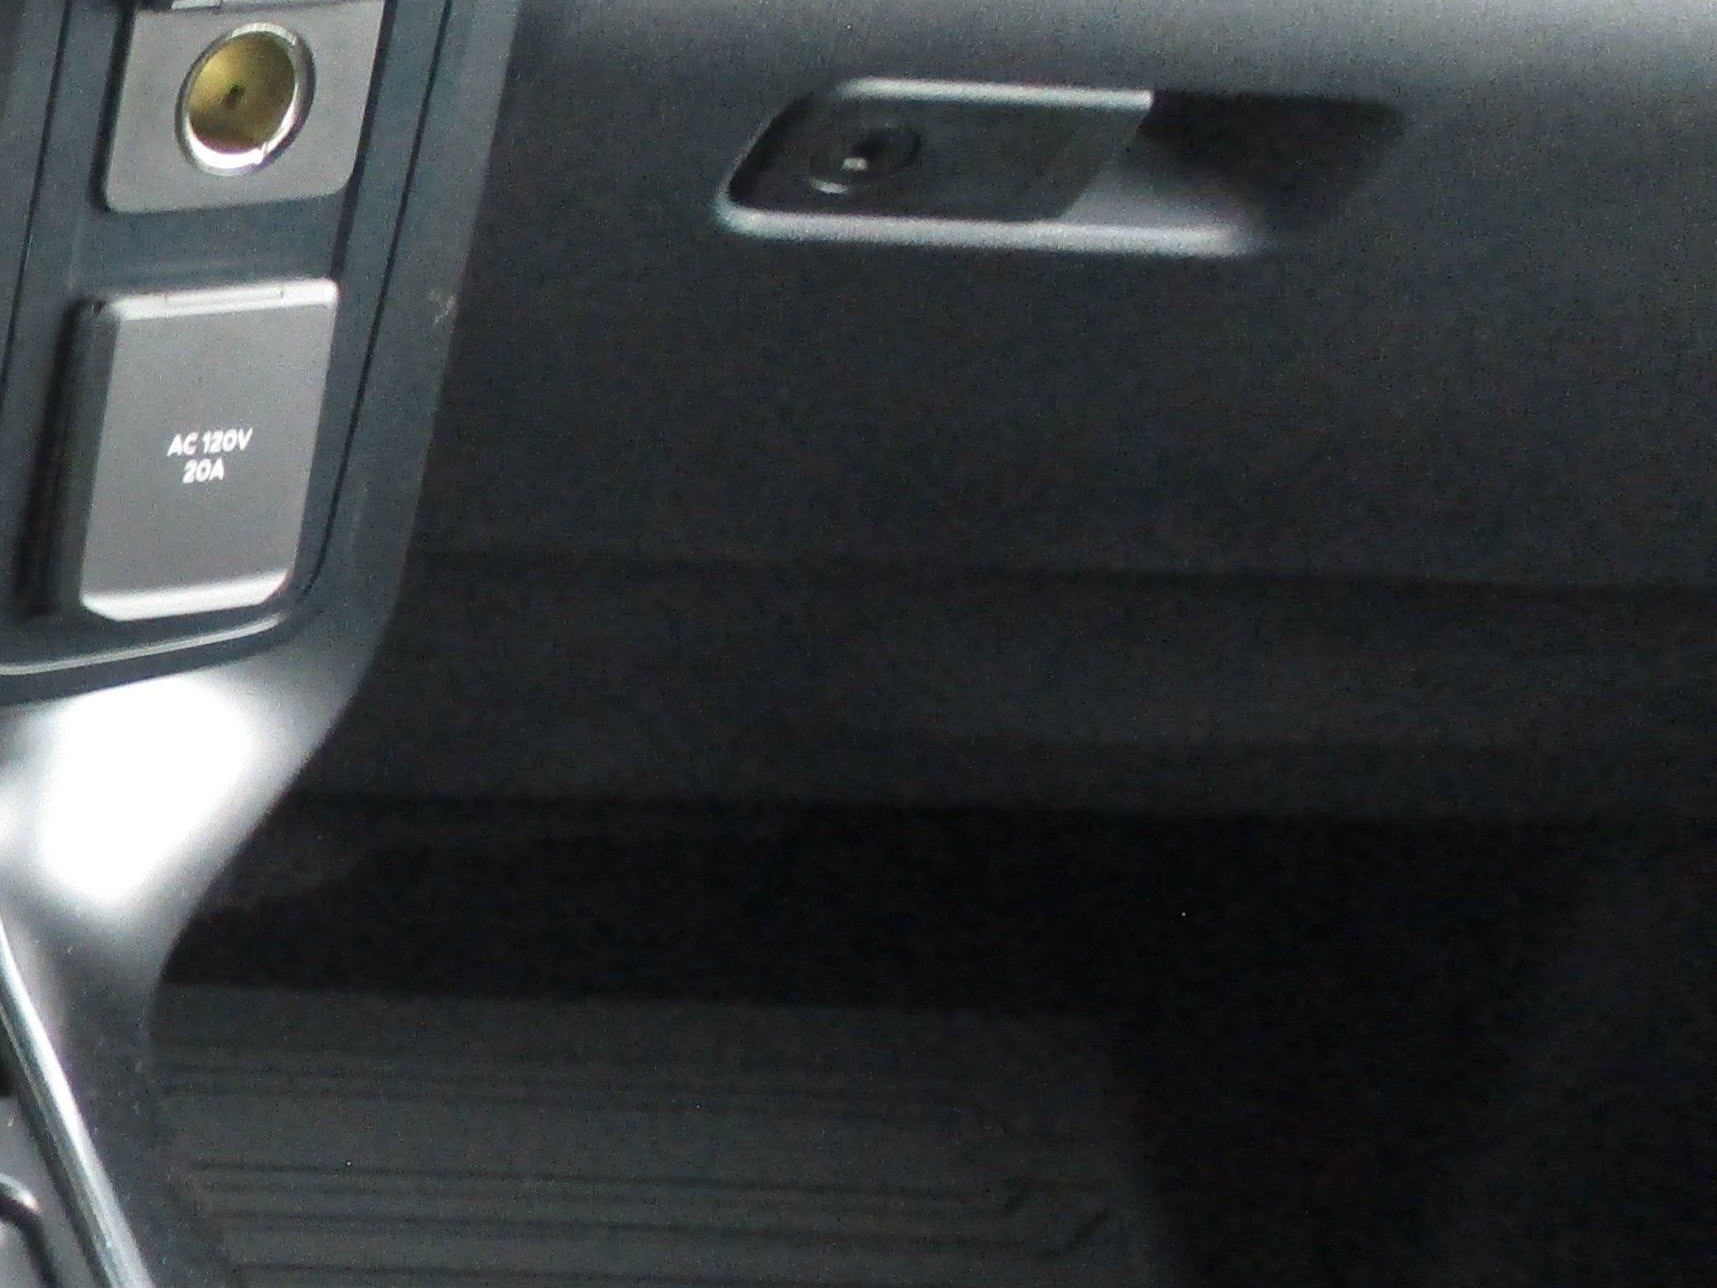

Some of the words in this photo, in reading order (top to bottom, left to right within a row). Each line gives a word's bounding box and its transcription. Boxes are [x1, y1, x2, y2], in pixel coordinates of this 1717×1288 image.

[166, 432, 199, 457] AC
[202, 426, 254, 454] 120V
[182, 458, 225, 484] 20A
